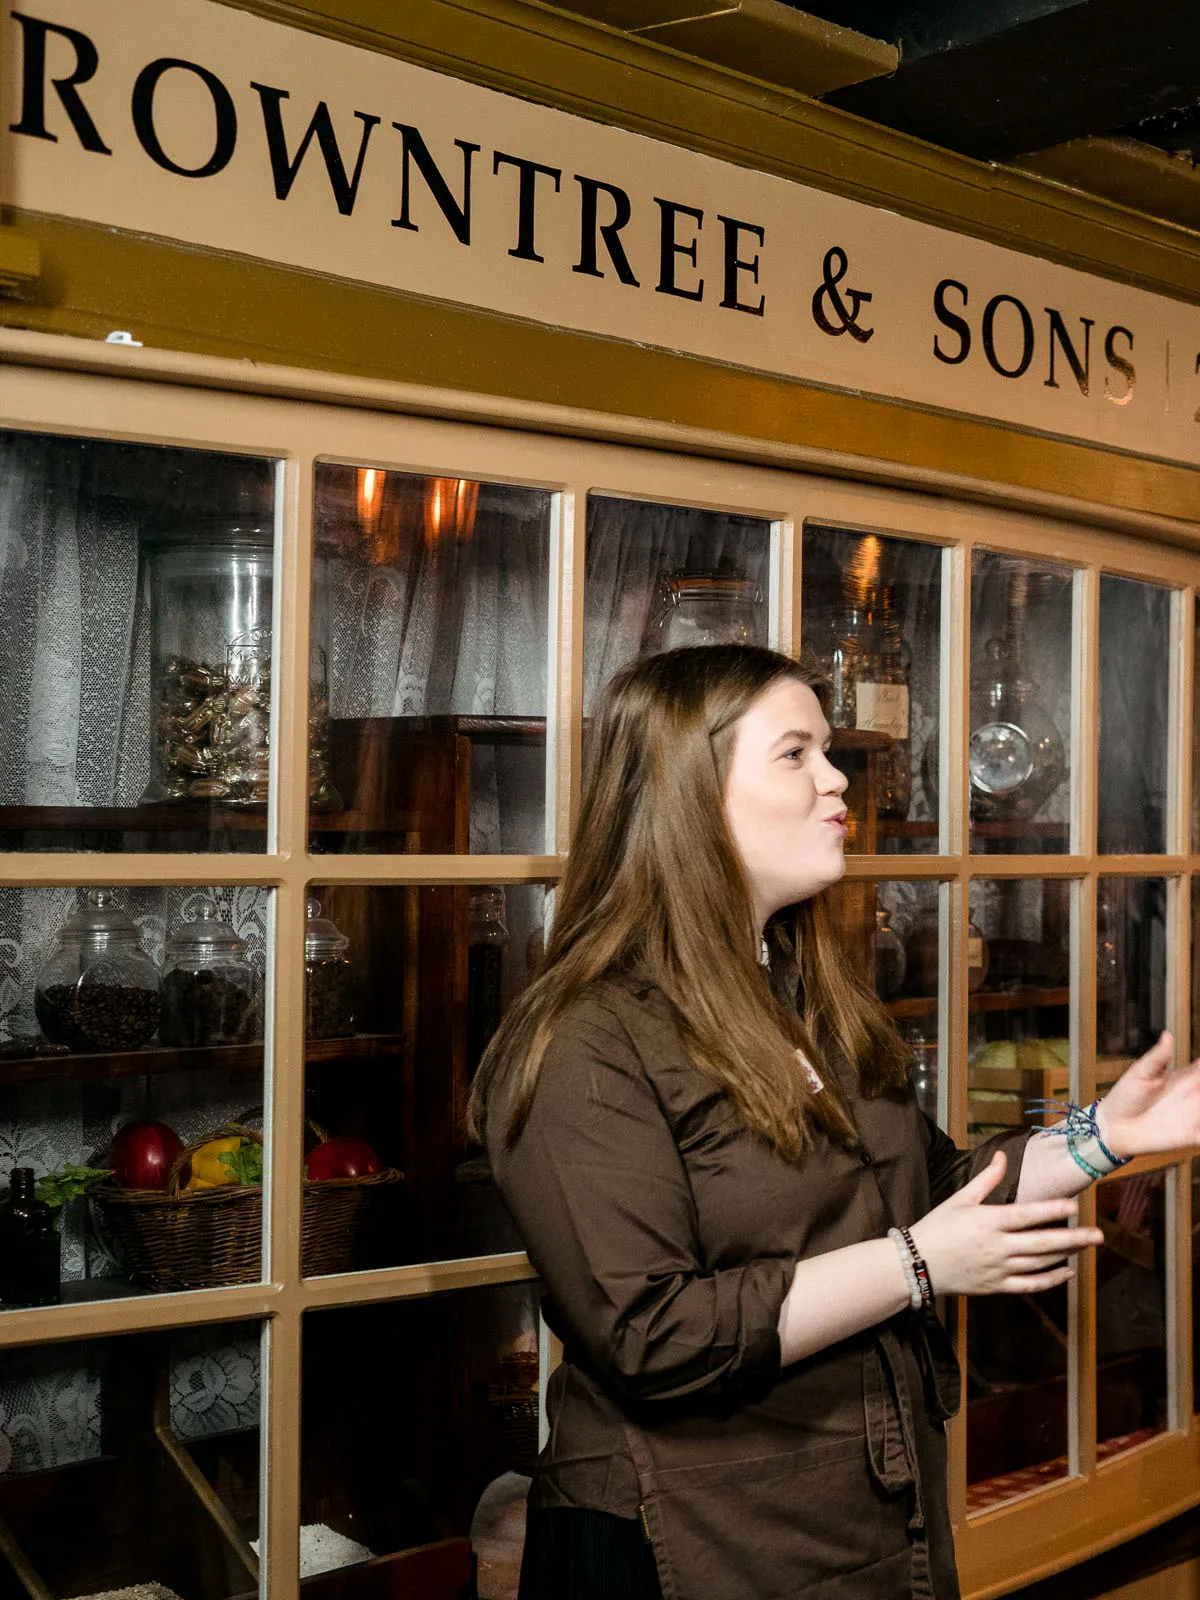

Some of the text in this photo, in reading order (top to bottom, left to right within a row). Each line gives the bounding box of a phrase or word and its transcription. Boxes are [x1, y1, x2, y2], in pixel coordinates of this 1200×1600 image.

[8, 10, 766, 318] ROWNTREE
[811, 245, 875, 344] &
[932, 278, 1137, 406] SONS
